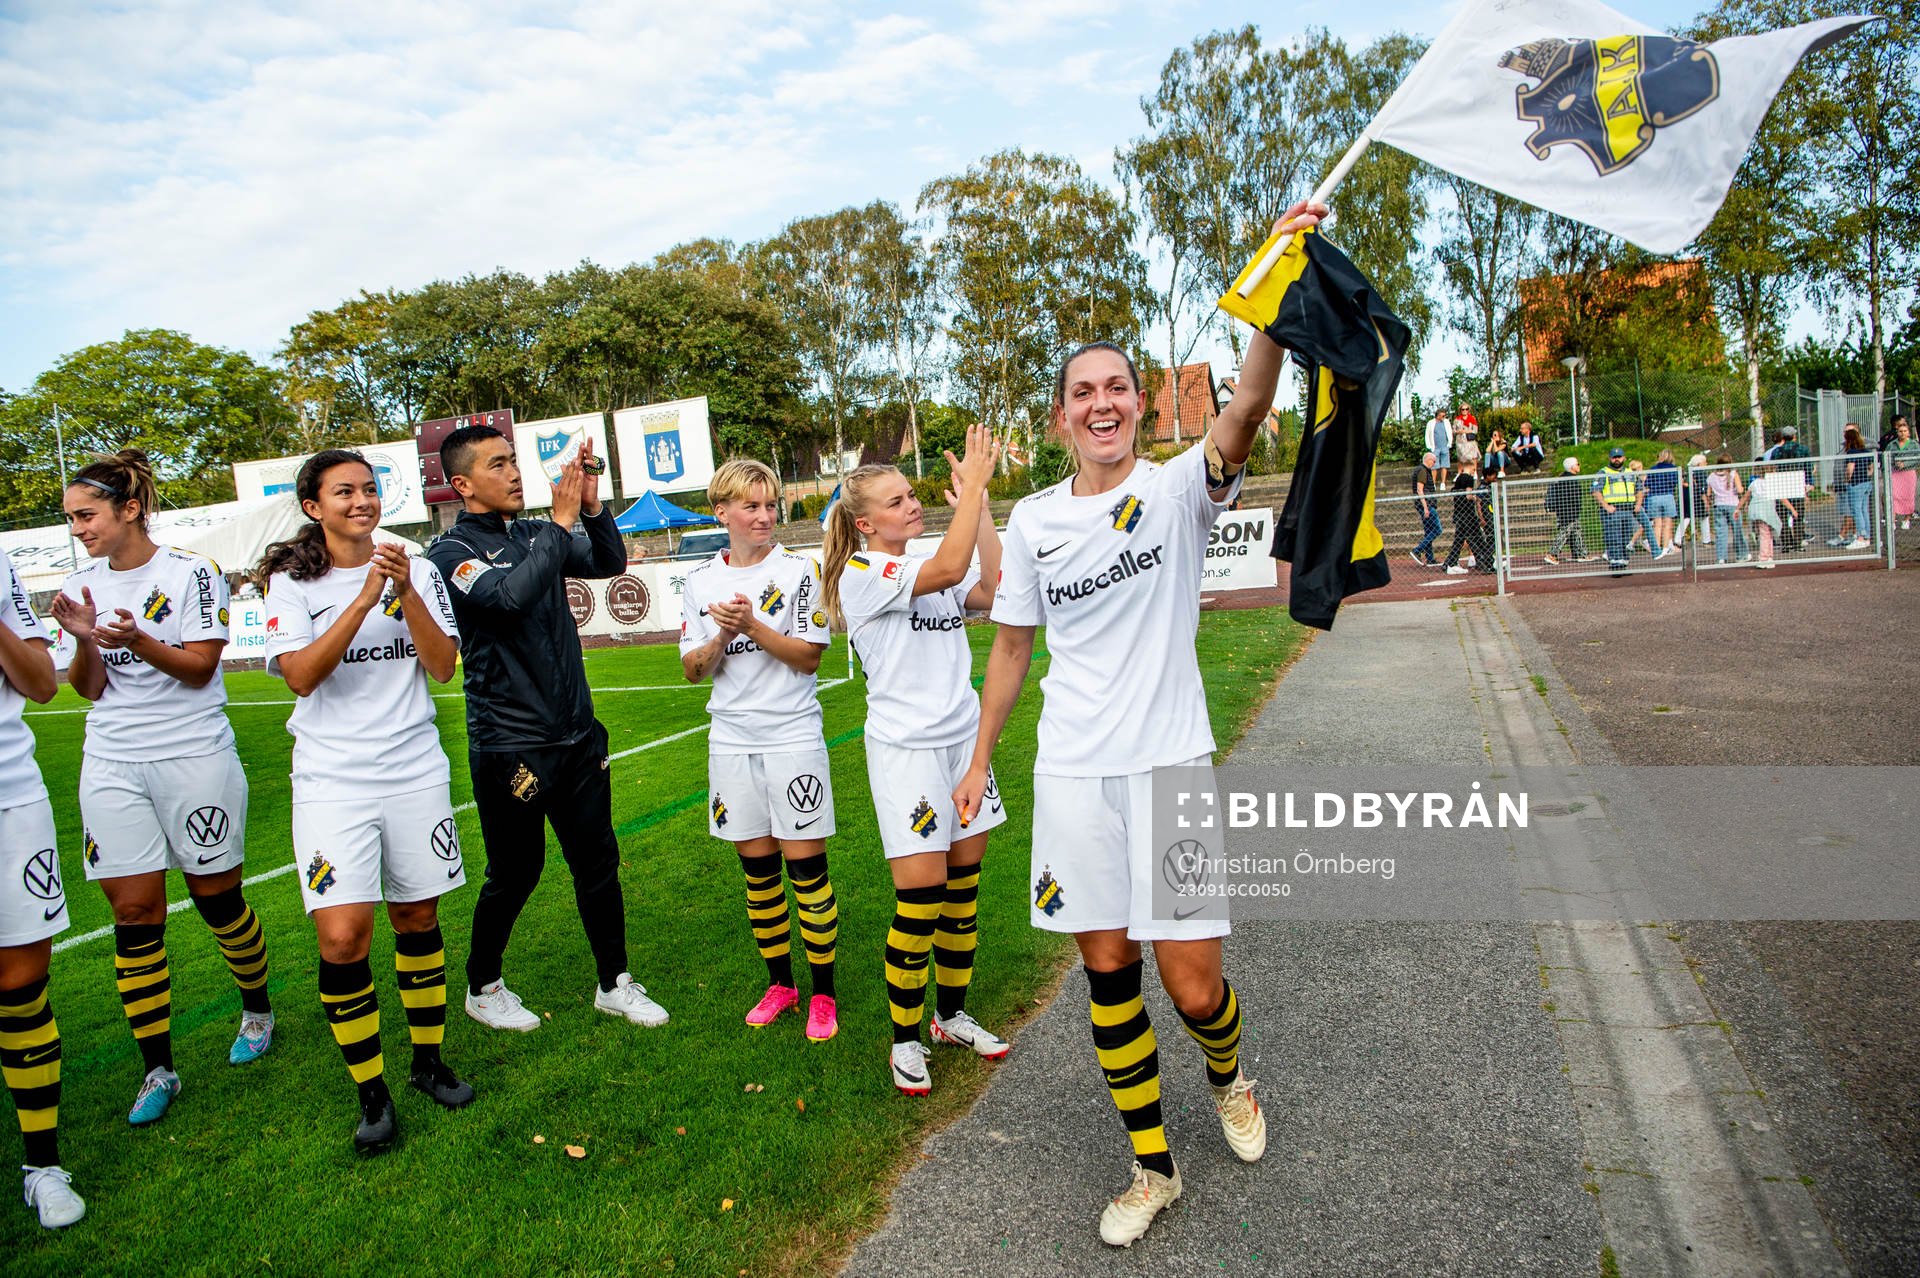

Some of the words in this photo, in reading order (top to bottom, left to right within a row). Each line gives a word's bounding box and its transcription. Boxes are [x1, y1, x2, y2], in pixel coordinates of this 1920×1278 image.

[540, 439, 561, 453] IFK
[1205, 545, 1248, 558] BORG
[1046, 544, 1163, 606] truecaller
[193, 567, 215, 630] stadium
[797, 575, 813, 634] stadium
[244, 611, 263, 627] EL
